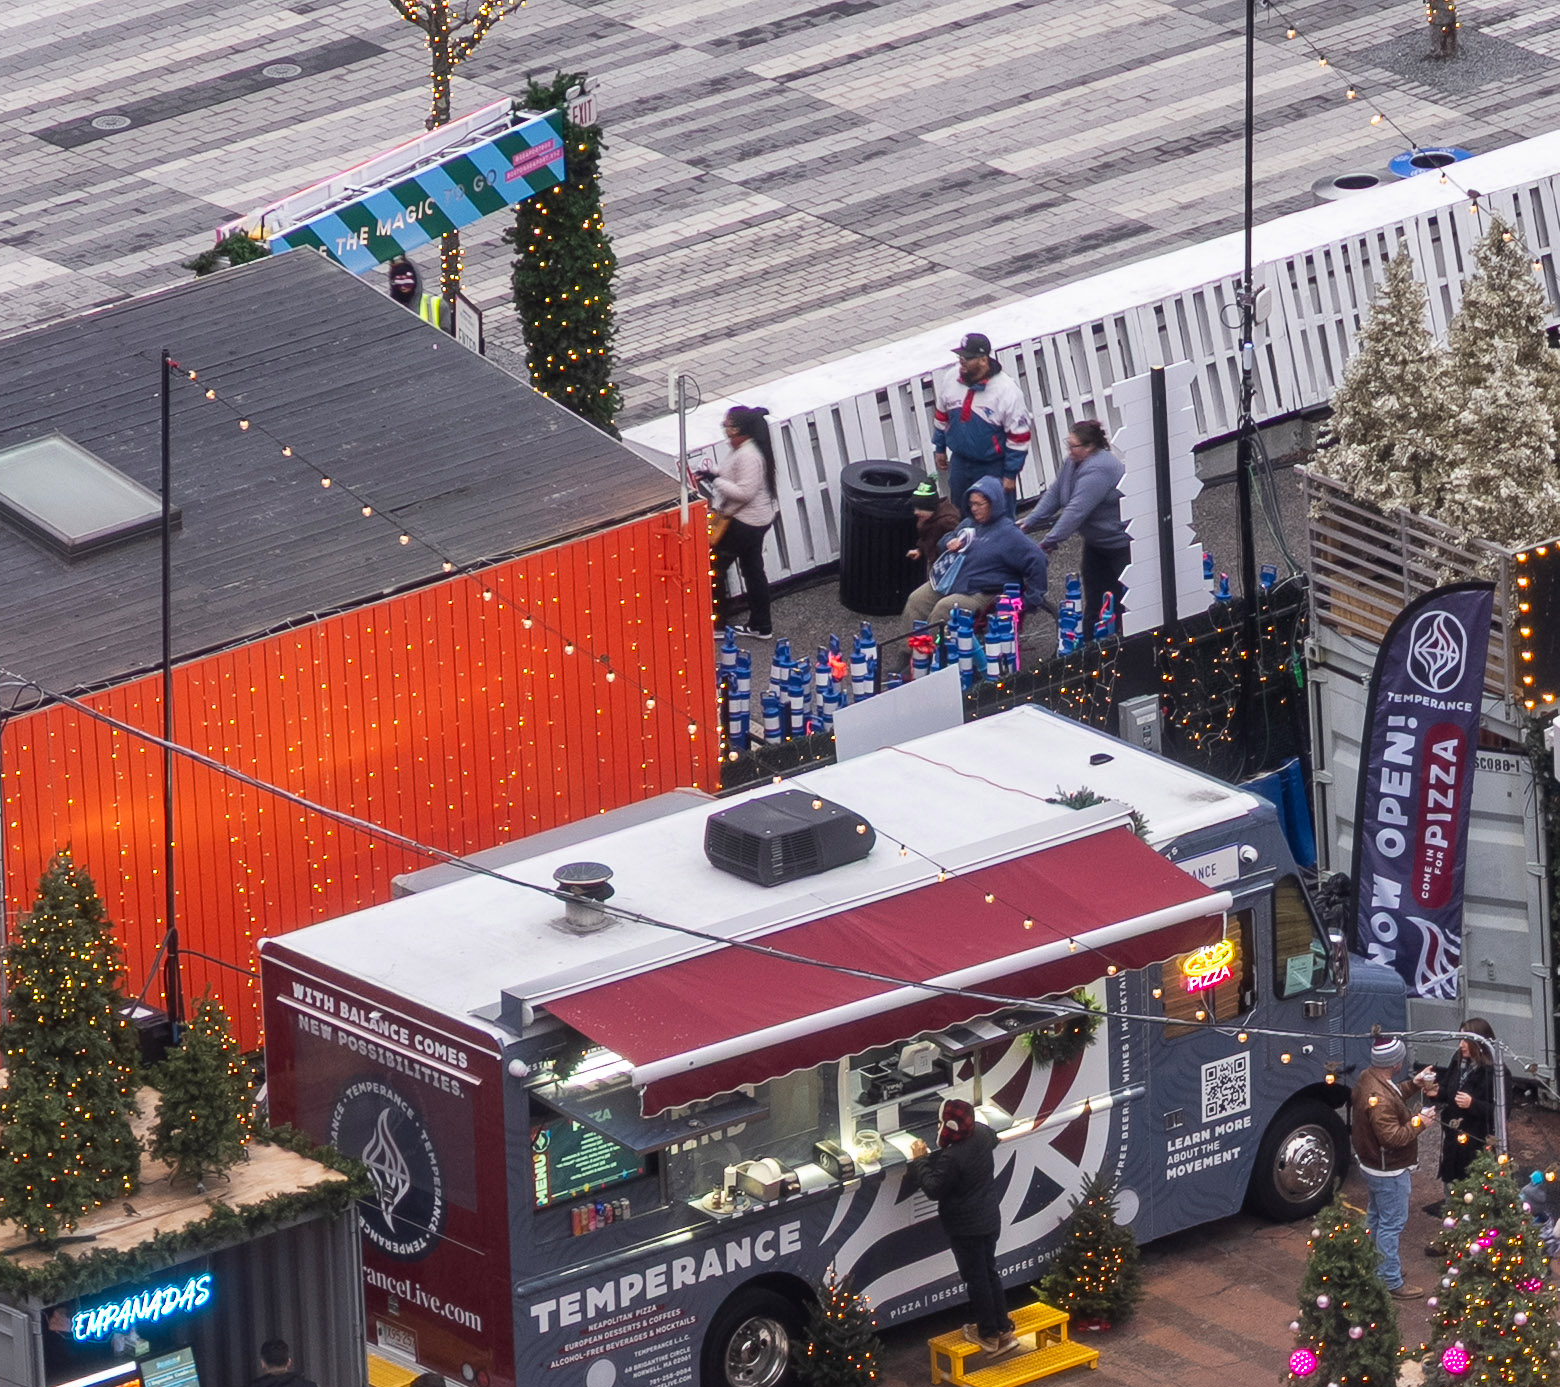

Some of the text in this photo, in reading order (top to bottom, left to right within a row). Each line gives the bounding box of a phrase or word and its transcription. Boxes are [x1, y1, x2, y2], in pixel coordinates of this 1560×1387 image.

[572, 99, 592, 124] EXIT
[1387, 691, 1473, 713] TEMPERANCE
[1424, 737, 1459, 849] PIZZA
[1363, 714, 1420, 970] NOW OPEN!
[1187, 964, 1233, 993] PIZZA
[292, 981, 469, 1069] WITH BALANCE COMES
[297, 1013, 466, 1099] NEW POSSIBILITIES.
[344, 1080, 415, 1122] TEMPERANCE
[1166, 1140, 1220, 1166] ABOUT THE
[1167, 1115, 1252, 1153] LEARN MORE
[533, 1153, 550, 1206] MENU
[1165, 1145, 1242, 1181] MOVEMENT
[530, 1220, 802, 1335] TEMPERANCE
[71, 1272, 214, 1343] EMPANADAS
[587, 1303, 658, 1332] NEAPOLITAN PIZZA
